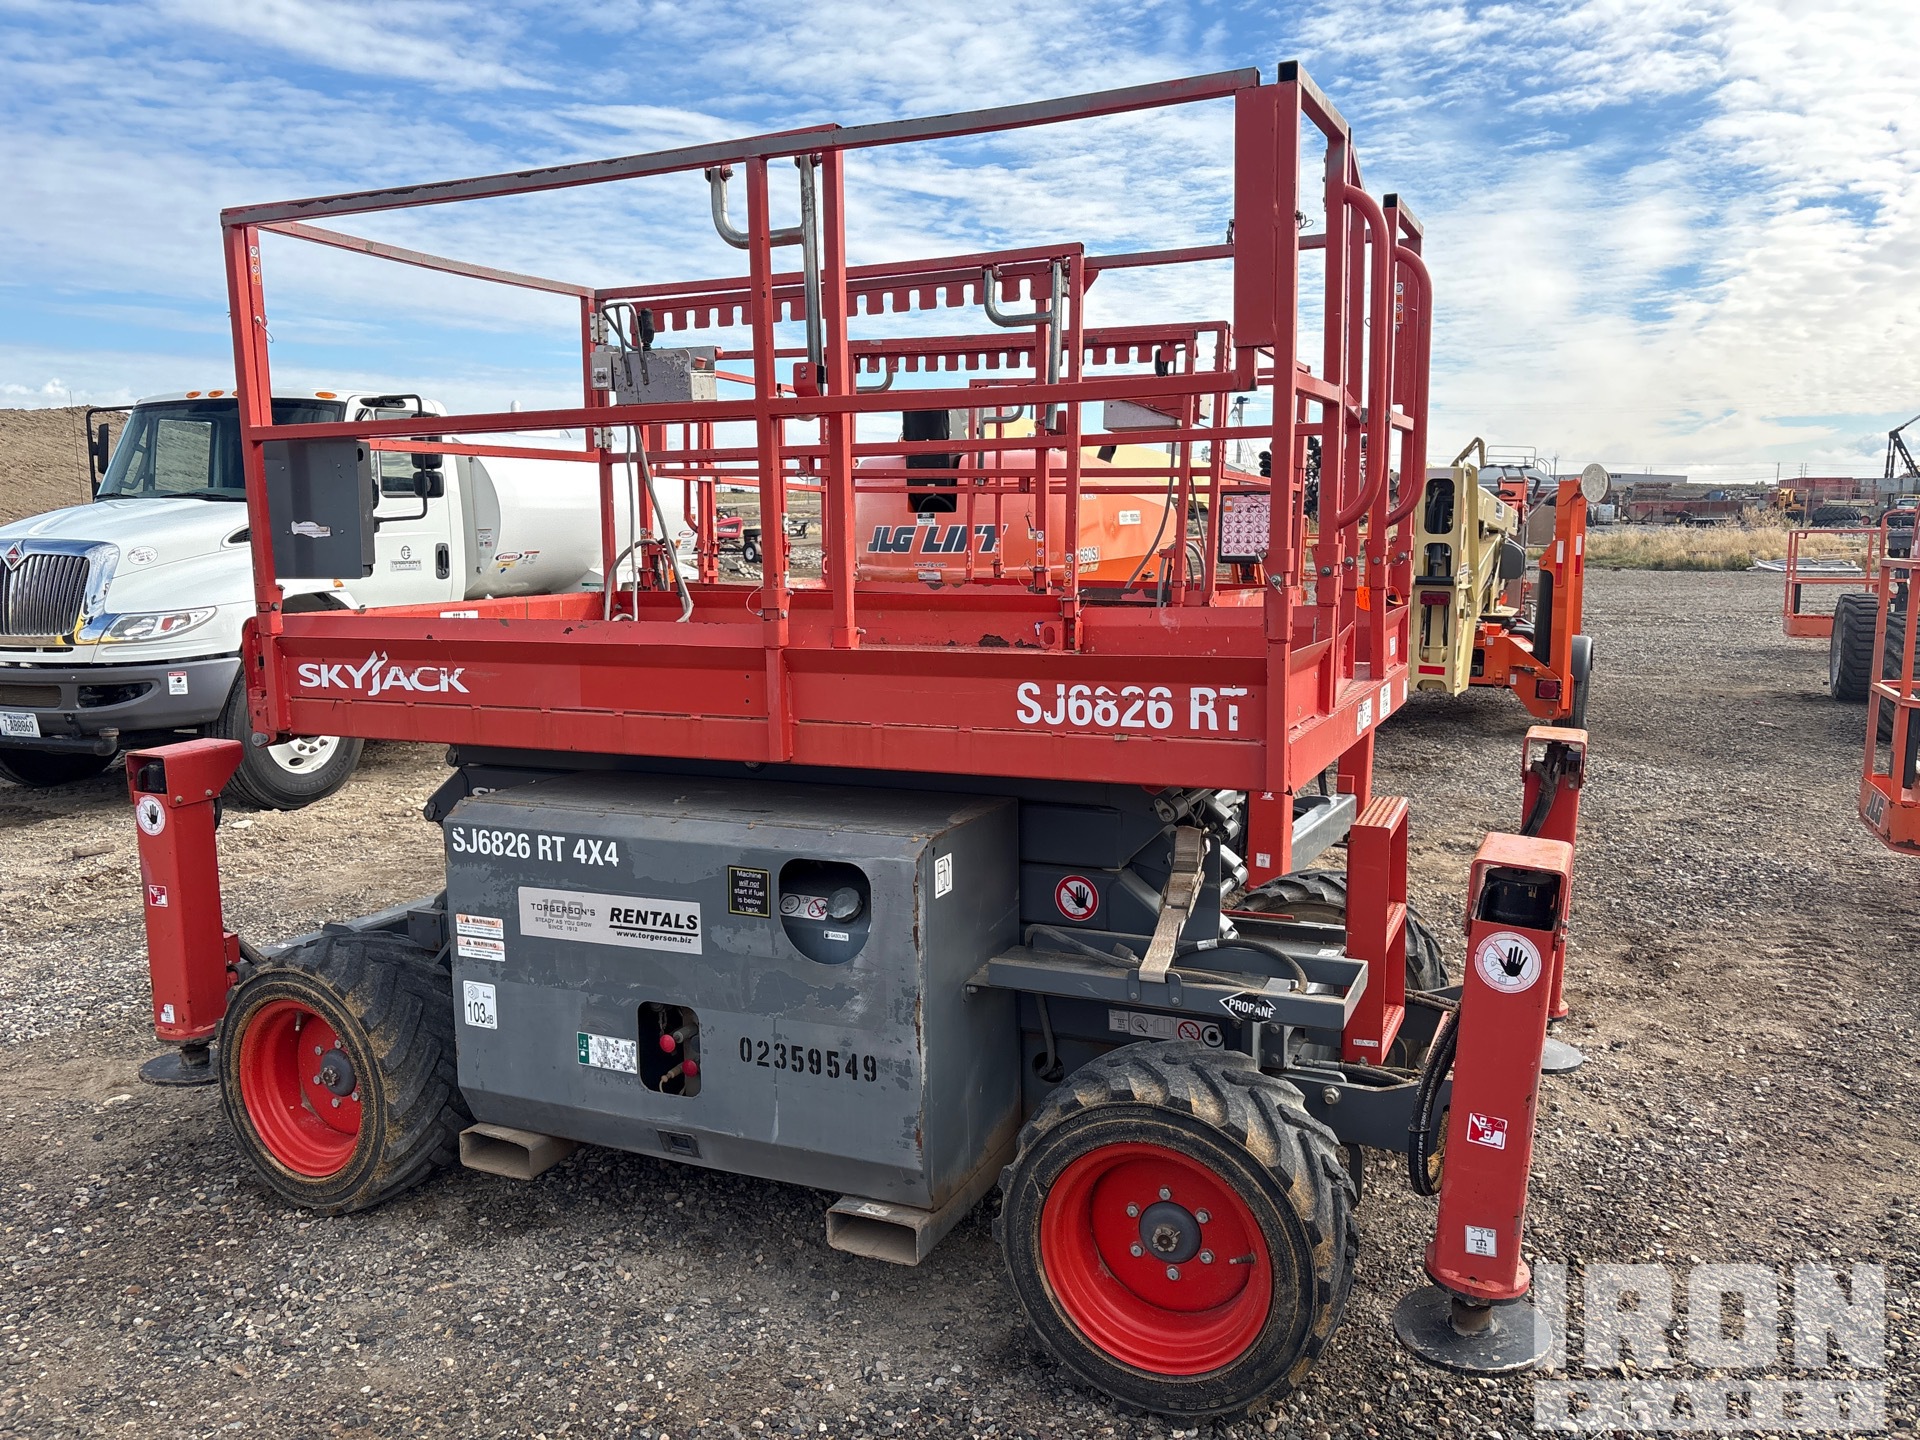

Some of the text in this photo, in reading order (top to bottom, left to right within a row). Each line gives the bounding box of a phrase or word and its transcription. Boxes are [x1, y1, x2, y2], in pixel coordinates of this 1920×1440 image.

[867, 526, 917, 553] JLG
[297, 650, 470, 696] SKYJACK
[1016, 681, 1248, 731] SJ6826 RT
[452, 826, 619, 867] SJ6826 RT 4X4
[737, 870, 762, 879] Machine
[753, 889, 765, 897] fuel
[743, 897, 761, 905] below
[531, 902, 596, 917] TORGERSON'S
[472, 918, 495, 926] WARNING
[535, 916, 555, 925] STEADY
[610, 907, 698, 931] RENTALS
[548, 923, 564, 931] SINCE
[473, 940, 497, 949] WARNING
[616, 931, 692, 944] www.torgerson.biz
[1229, 998, 1274, 1019] PROPANE
[740, 1037, 877, 1082] 02359549
[1058, 1106, 1153, 1134] OUTRIGGER
